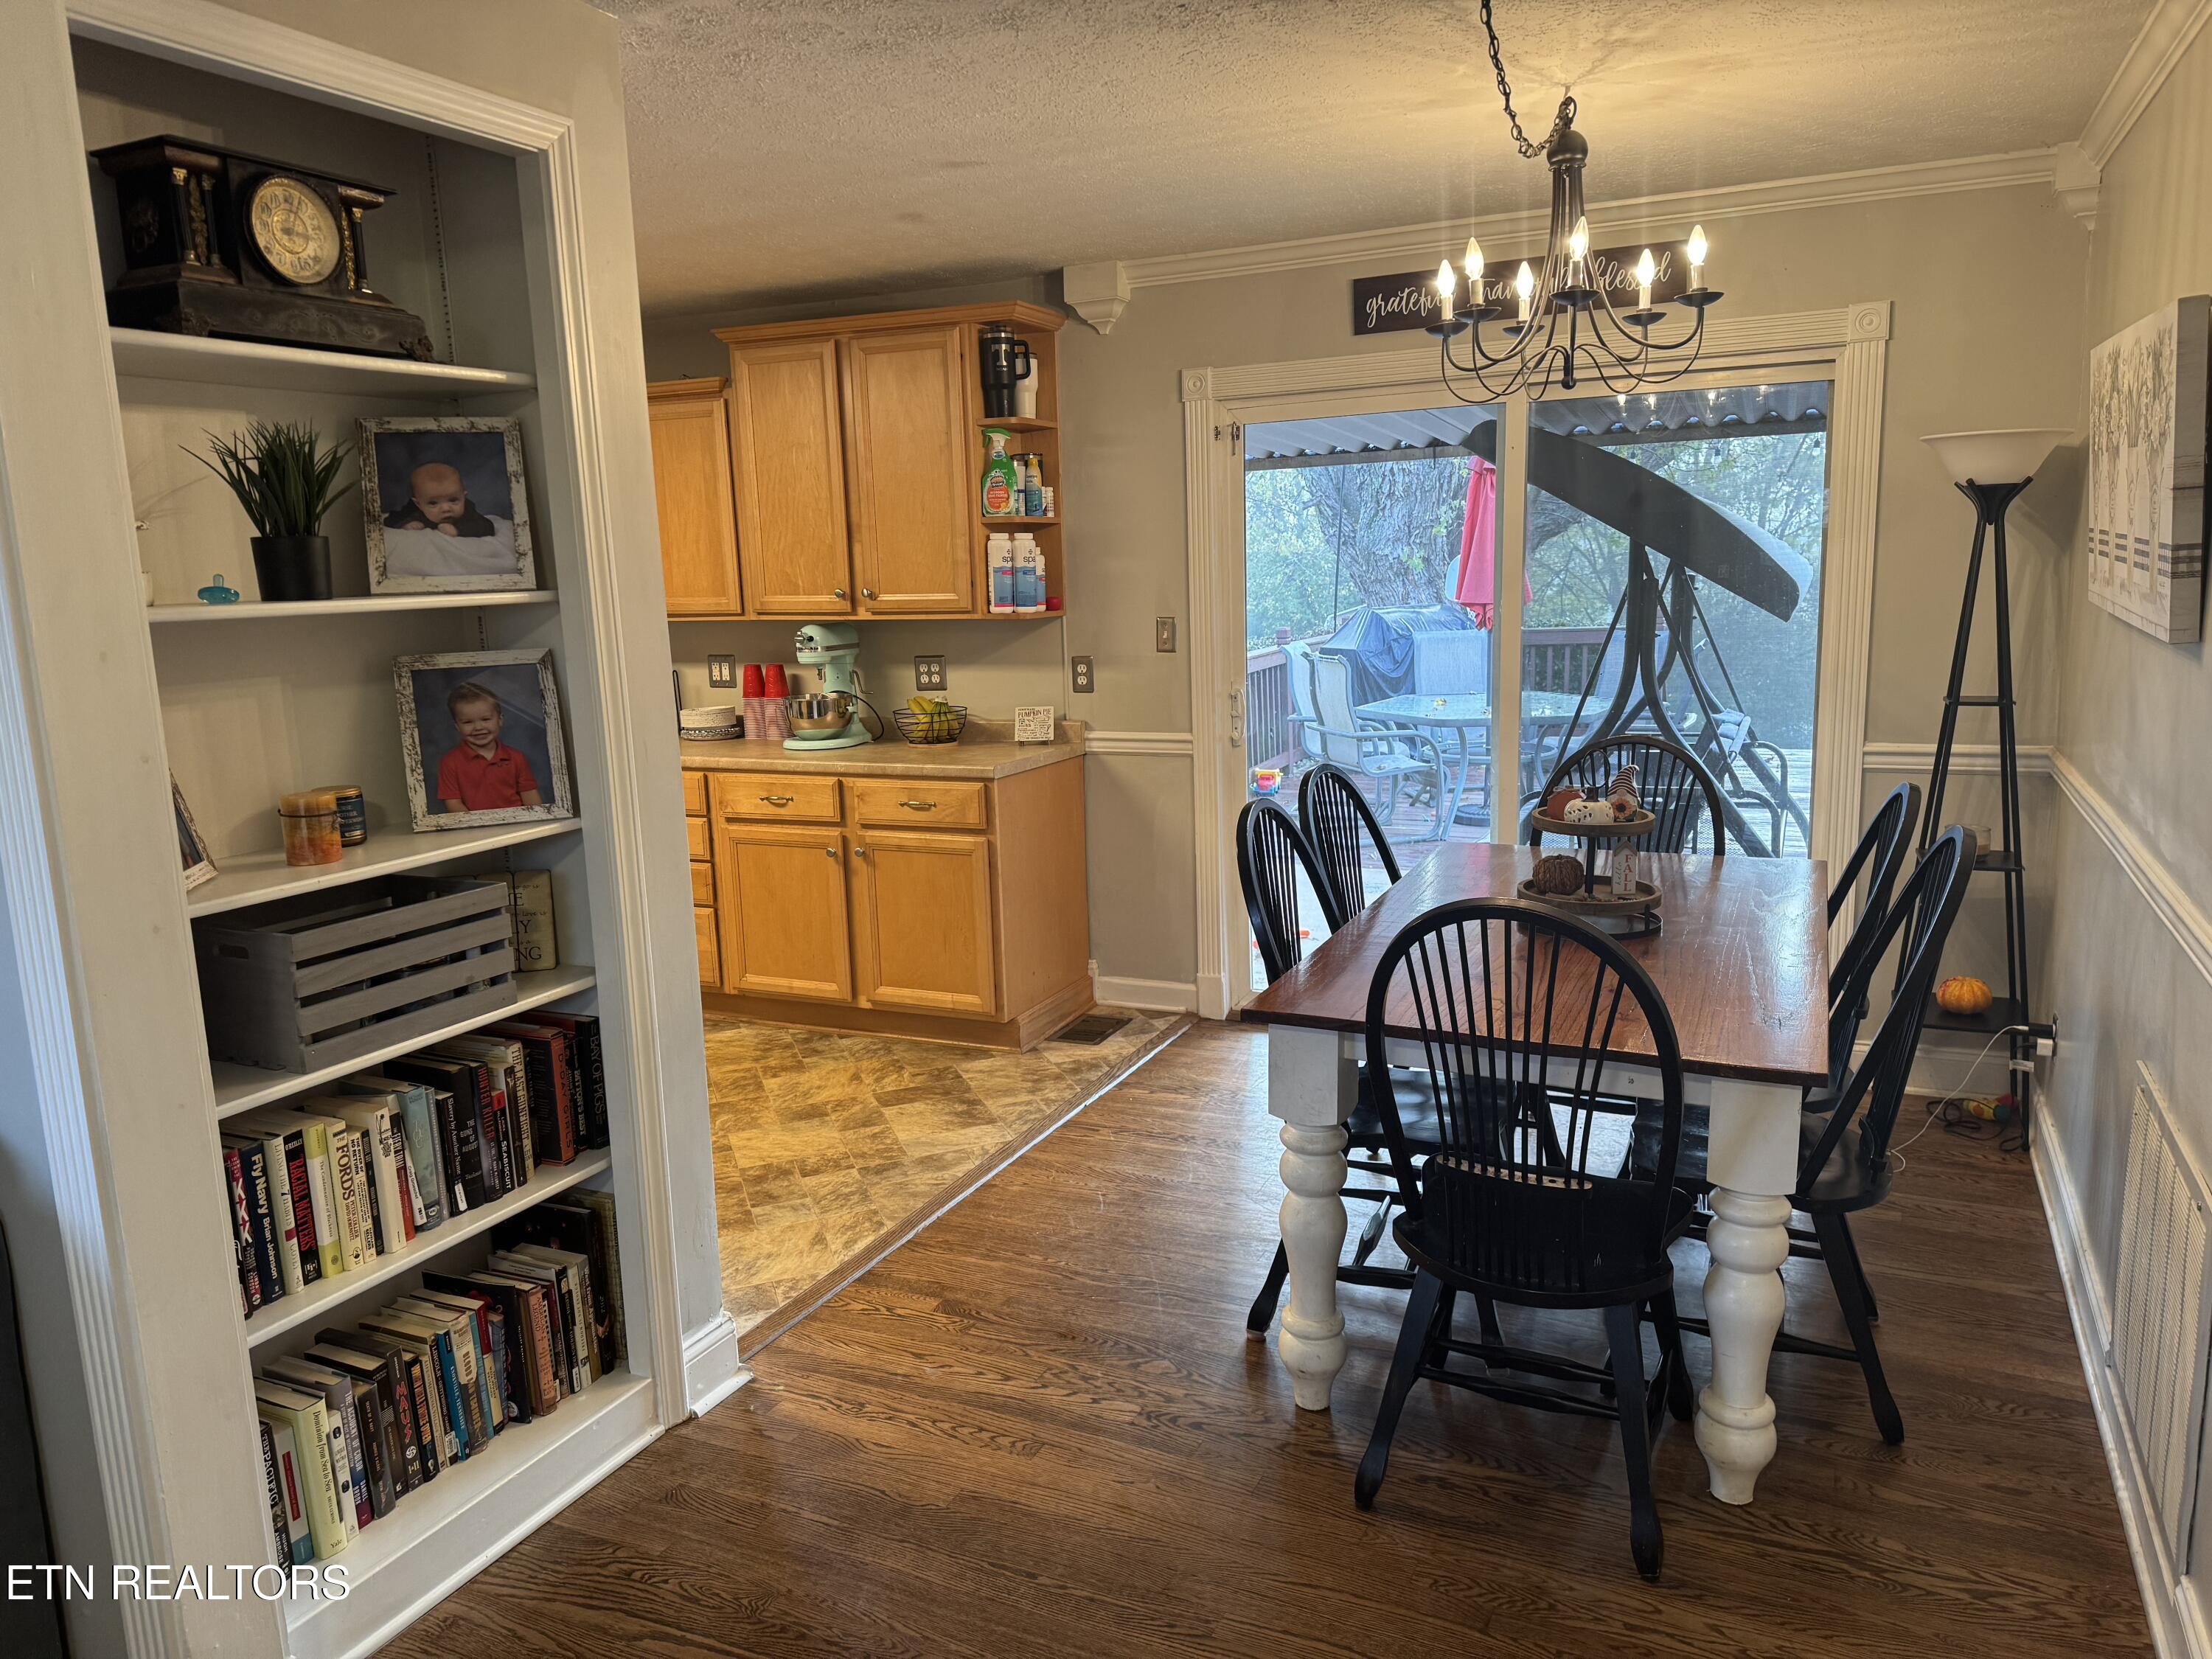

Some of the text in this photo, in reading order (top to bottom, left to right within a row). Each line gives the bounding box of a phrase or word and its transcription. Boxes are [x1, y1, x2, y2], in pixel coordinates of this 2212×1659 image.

[1366, 286, 1455, 328] gratefu
[1593, 251, 1672, 291] blesd
[991, 344, 1010, 366] T
[1018, 709, 1041, 718] PUMPKIN
[1624, 854, 1632, 891] FALL
[574, 1069, 583, 1112] PATTON'S
[589, 1035, 605, 1114] BAY OF PIGS
[478, 1067, 495, 1139] HUNTER KILLER
[511, 1047, 529, 1140] THE LAST GUNFIGHT
[558, 1053, 567, 1098] D-DAY
[563, 1104, 571, 1148] GIRLS
[446, 1097, 462, 1175] Slavery by Another Name
[460, 1127, 473, 1138] GUNS
[467, 1119, 476, 1127] THE
[470, 1135, 476, 1143] OF
[274, 1143, 284, 1172] LIVING
[349, 1138, 360, 1175] NO RETURN
[462, 1141, 479, 1153] AUGUST
[335, 1144, 355, 1201] FORDS
[359, 1165, 364, 1174] OF
[501, 1141, 511, 1189] SEABISCUIT
[251, 1152, 269, 1214] Fly Navy
[281, 1189, 291, 1197] 7
[410, 1177, 419, 1199] Groeschel
[282, 1197, 293, 1227] HABITS
[349, 1200, 360, 1239] PETER COLLIER
[262, 1217, 278, 1279] Brian Johnson
[532, 1304, 540, 1332] LEGEND
[537, 1297, 546, 1334] AMERICAN
[431, 1346, 441, 1376] LINCOLN
[438, 1380, 448, 1415] GETTYSBURG
[462, 1351, 473, 1377] BLOOD
[396, 1381, 413, 1444] MAUS
[414, 1385, 425, 1404] HELL
[420, 1422, 431, 1445] OVER
[450, 1366, 465, 1430] KNOXVILLE, TENNESSEE
[313, 1410, 324, 1442] Dominion
[344, 1391, 364, 1472] THE ACCIDENT OF COLOR
[319, 1442, 328, 1459] from
[321, 1459, 330, 1472] Sea
[261, 1433, 279, 1504] THE PACIFIC
[323, 1479, 333, 1492] Sea
[352, 1486, 361, 1505] BROOK
[359, 1480, 369, 1502] DANIEL
[274, 1532, 284, 1564] AMBROSE
[330, 1538, 343, 1549] Yale
